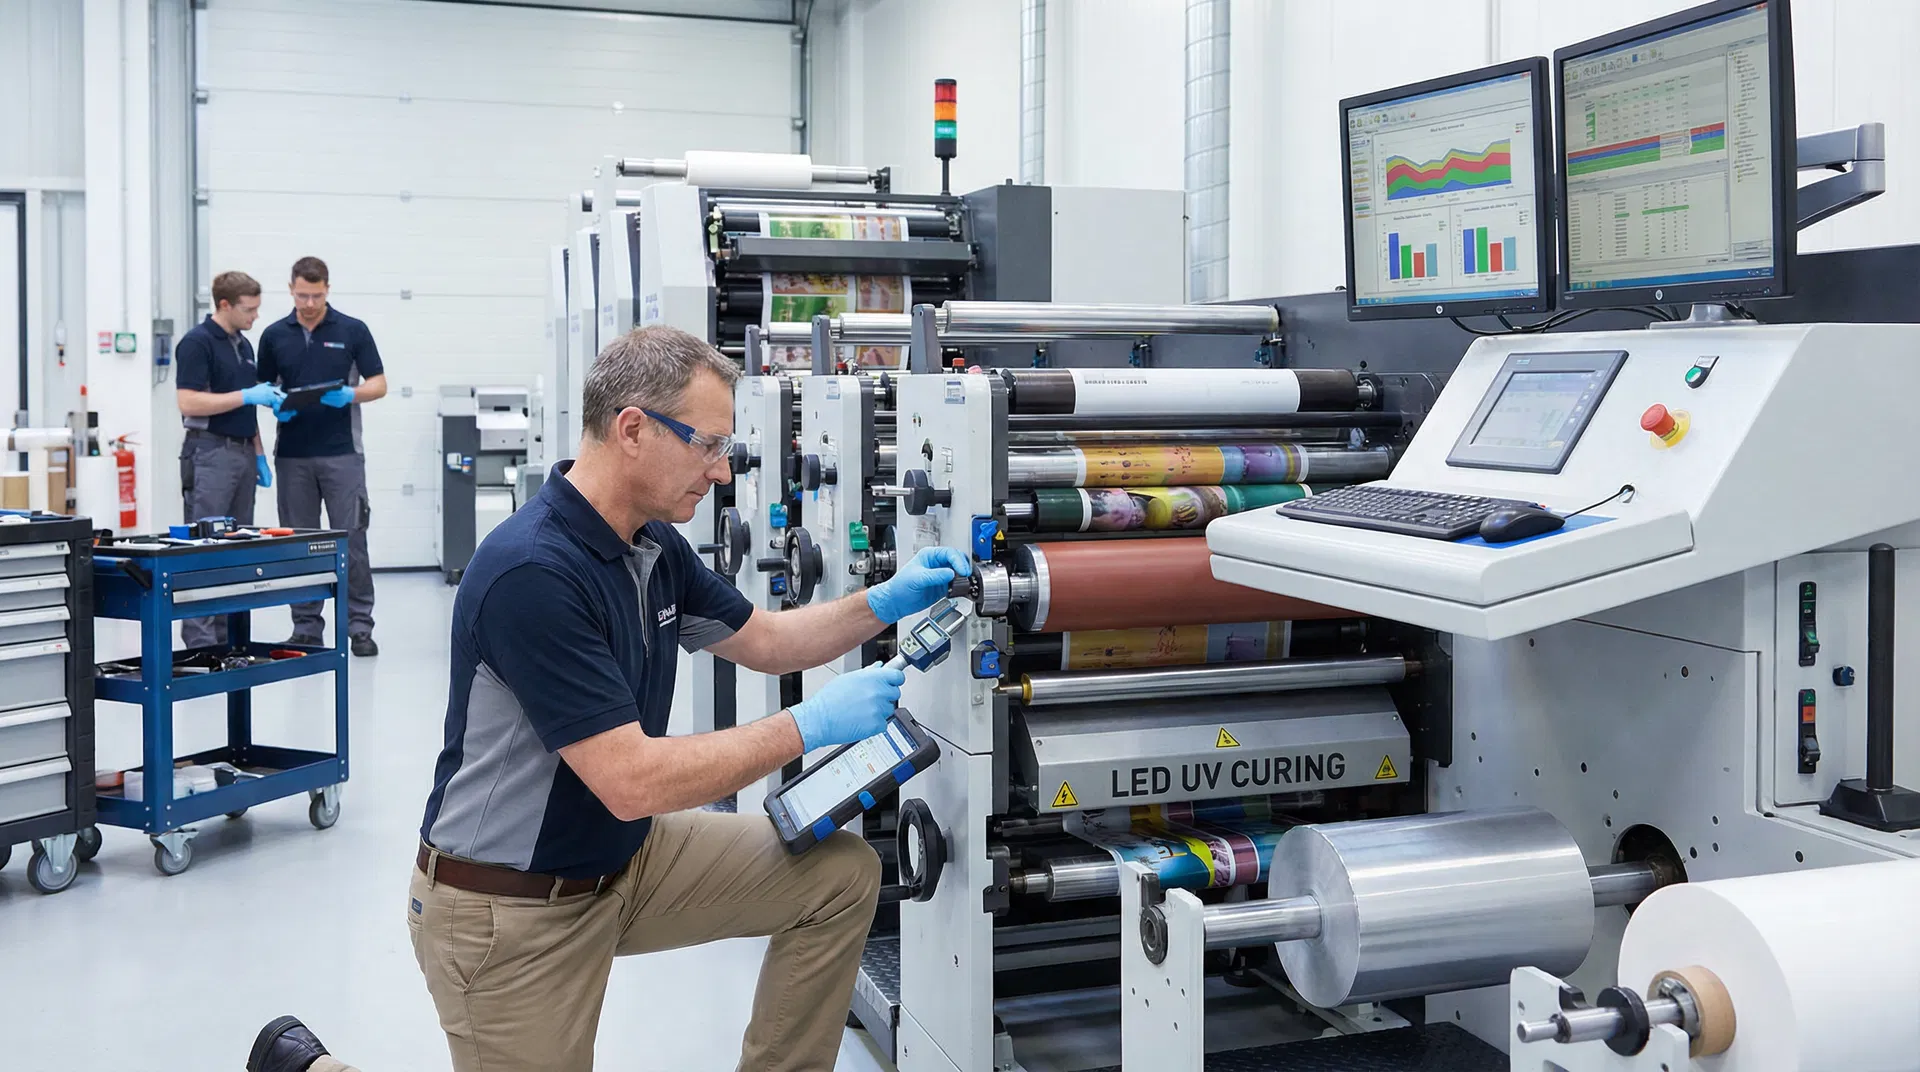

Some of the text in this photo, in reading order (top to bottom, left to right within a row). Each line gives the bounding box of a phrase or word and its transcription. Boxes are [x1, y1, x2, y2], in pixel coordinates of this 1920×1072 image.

[1112, 752, 1346, 798] LED UV CURING
